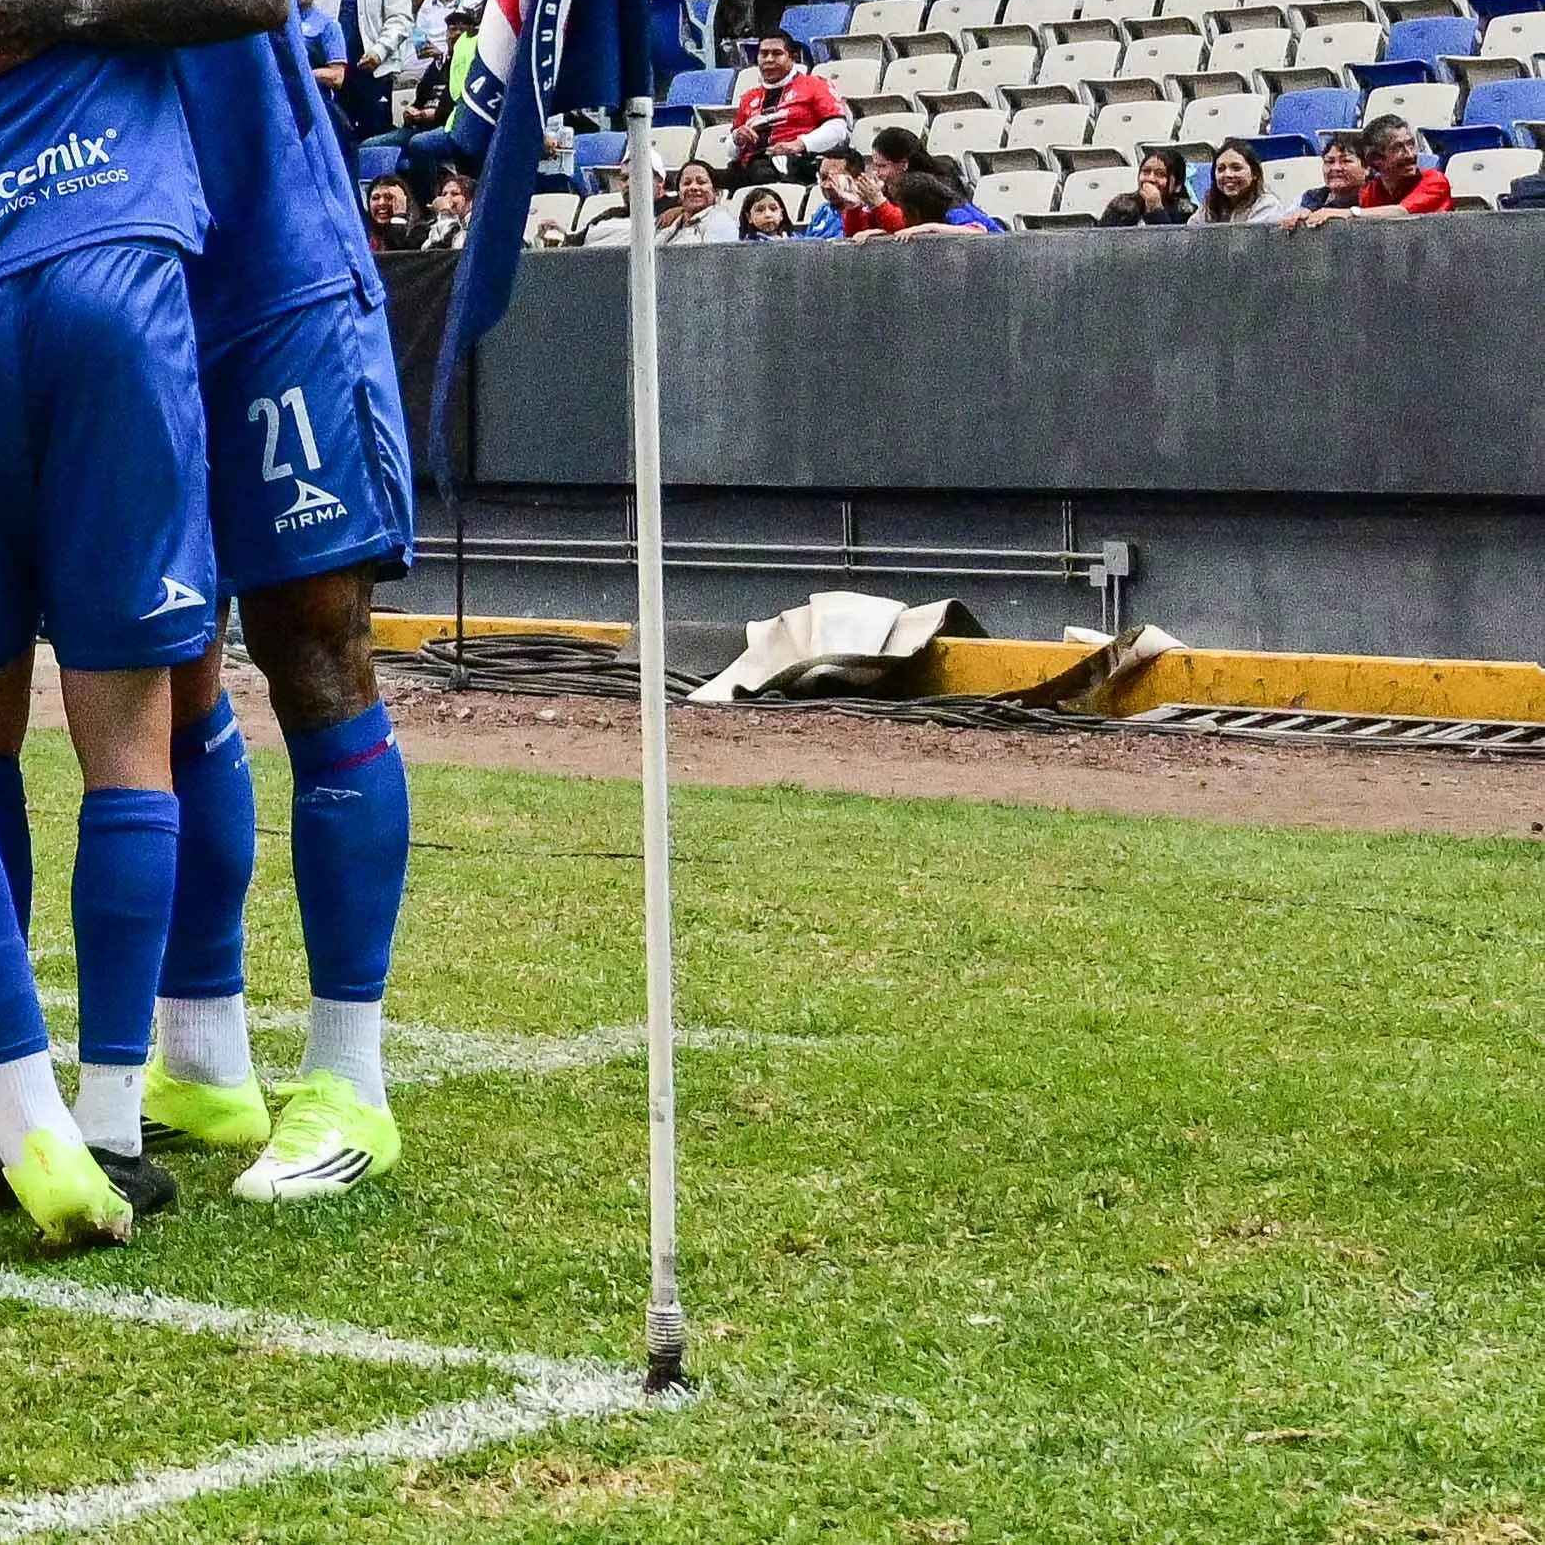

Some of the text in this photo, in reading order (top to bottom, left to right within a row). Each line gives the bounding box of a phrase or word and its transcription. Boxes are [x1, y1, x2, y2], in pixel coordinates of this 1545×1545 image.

[540, 3, 557, 92] CLUB
[469, 75, 504, 109] AZ
[39, 185, 53, 201] Y
[56, 168, 130, 196] ESTUCOS
[247, 386, 321, 482] 21
[274, 504, 348, 533] PIRMA
